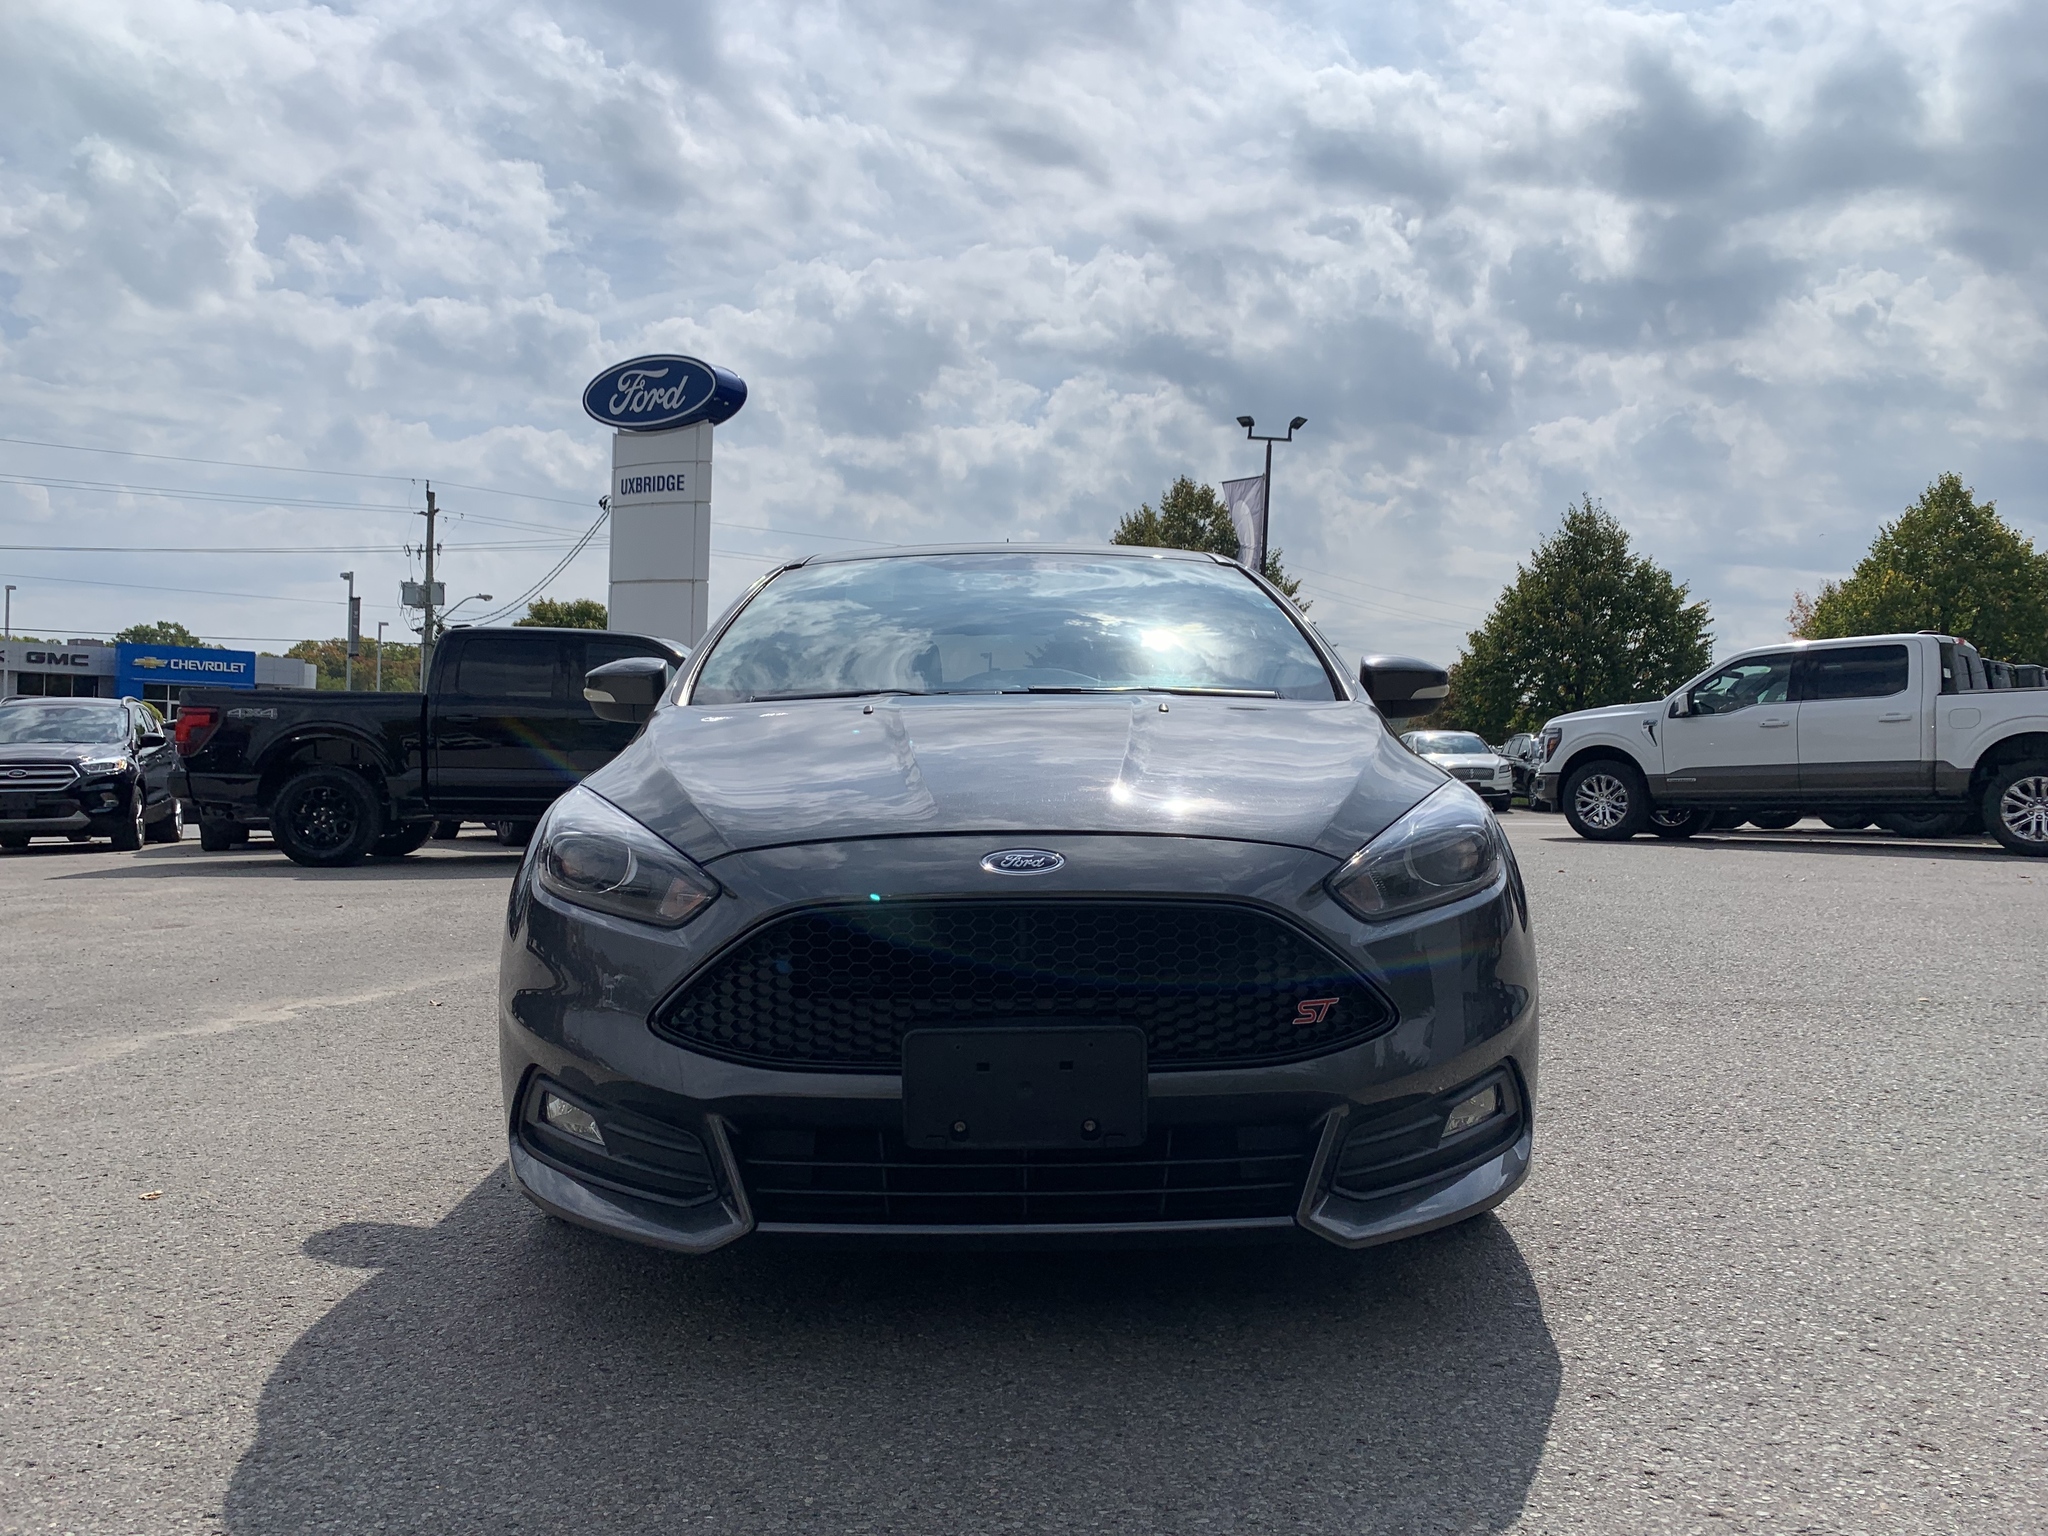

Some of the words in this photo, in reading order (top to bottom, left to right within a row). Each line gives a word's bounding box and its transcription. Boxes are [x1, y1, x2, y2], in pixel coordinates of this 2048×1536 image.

[608, 367, 689, 416] Ford
[620, 474, 686, 496] UXBRIDGE
[26, 651, 89, 667] GMC
[170, 659, 246, 673] CHEVROLET
[1000, 854, 1045, 868] Ford
[1292, 997, 1340, 1025] ST
